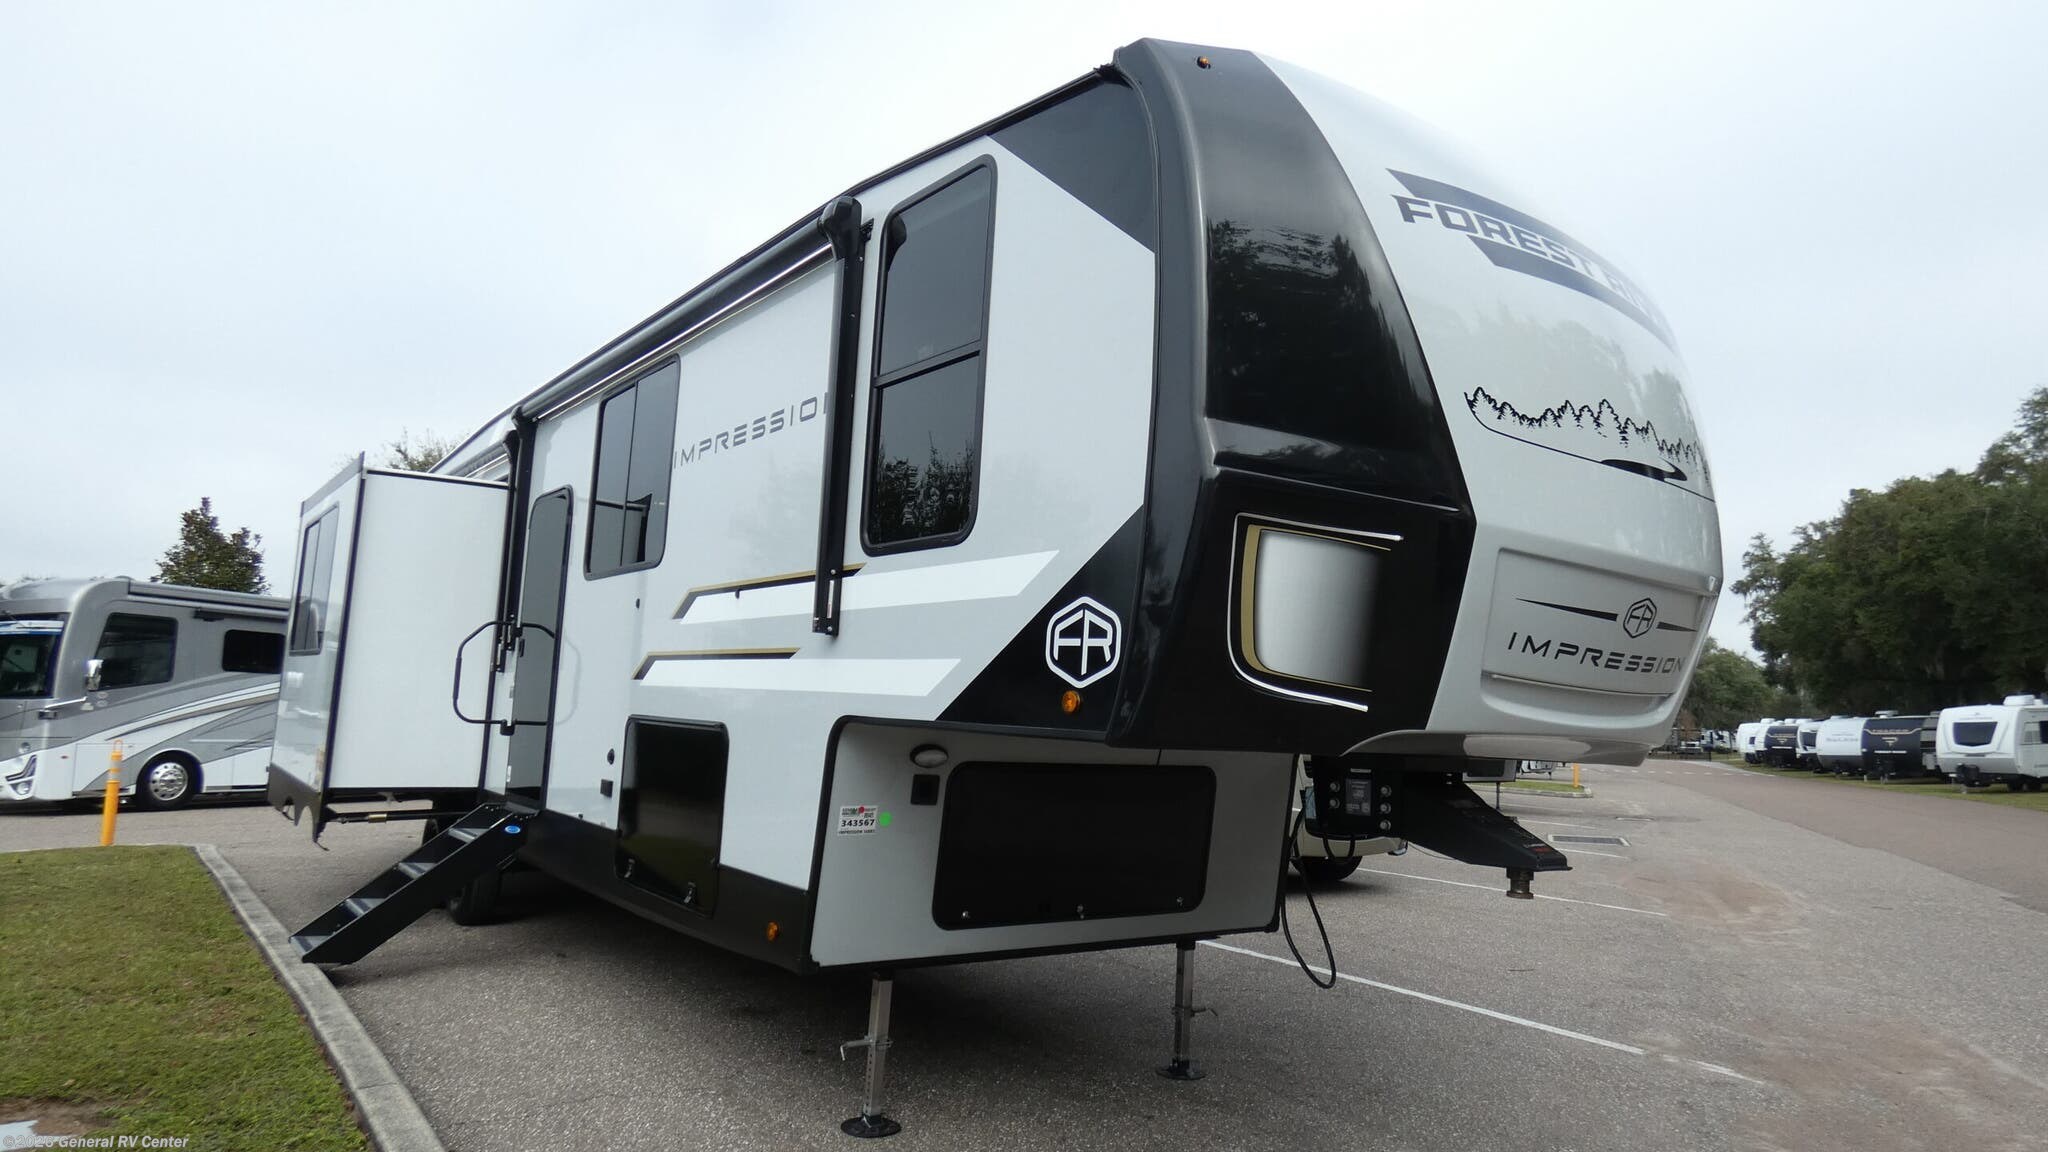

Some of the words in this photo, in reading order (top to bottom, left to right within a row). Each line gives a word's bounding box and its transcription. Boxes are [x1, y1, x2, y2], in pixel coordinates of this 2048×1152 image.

[1391, 194, 1594, 279] FOREST
[1507, 632, 1687, 674] IMPRESSION
[841, 819, 875, 827] 343567
